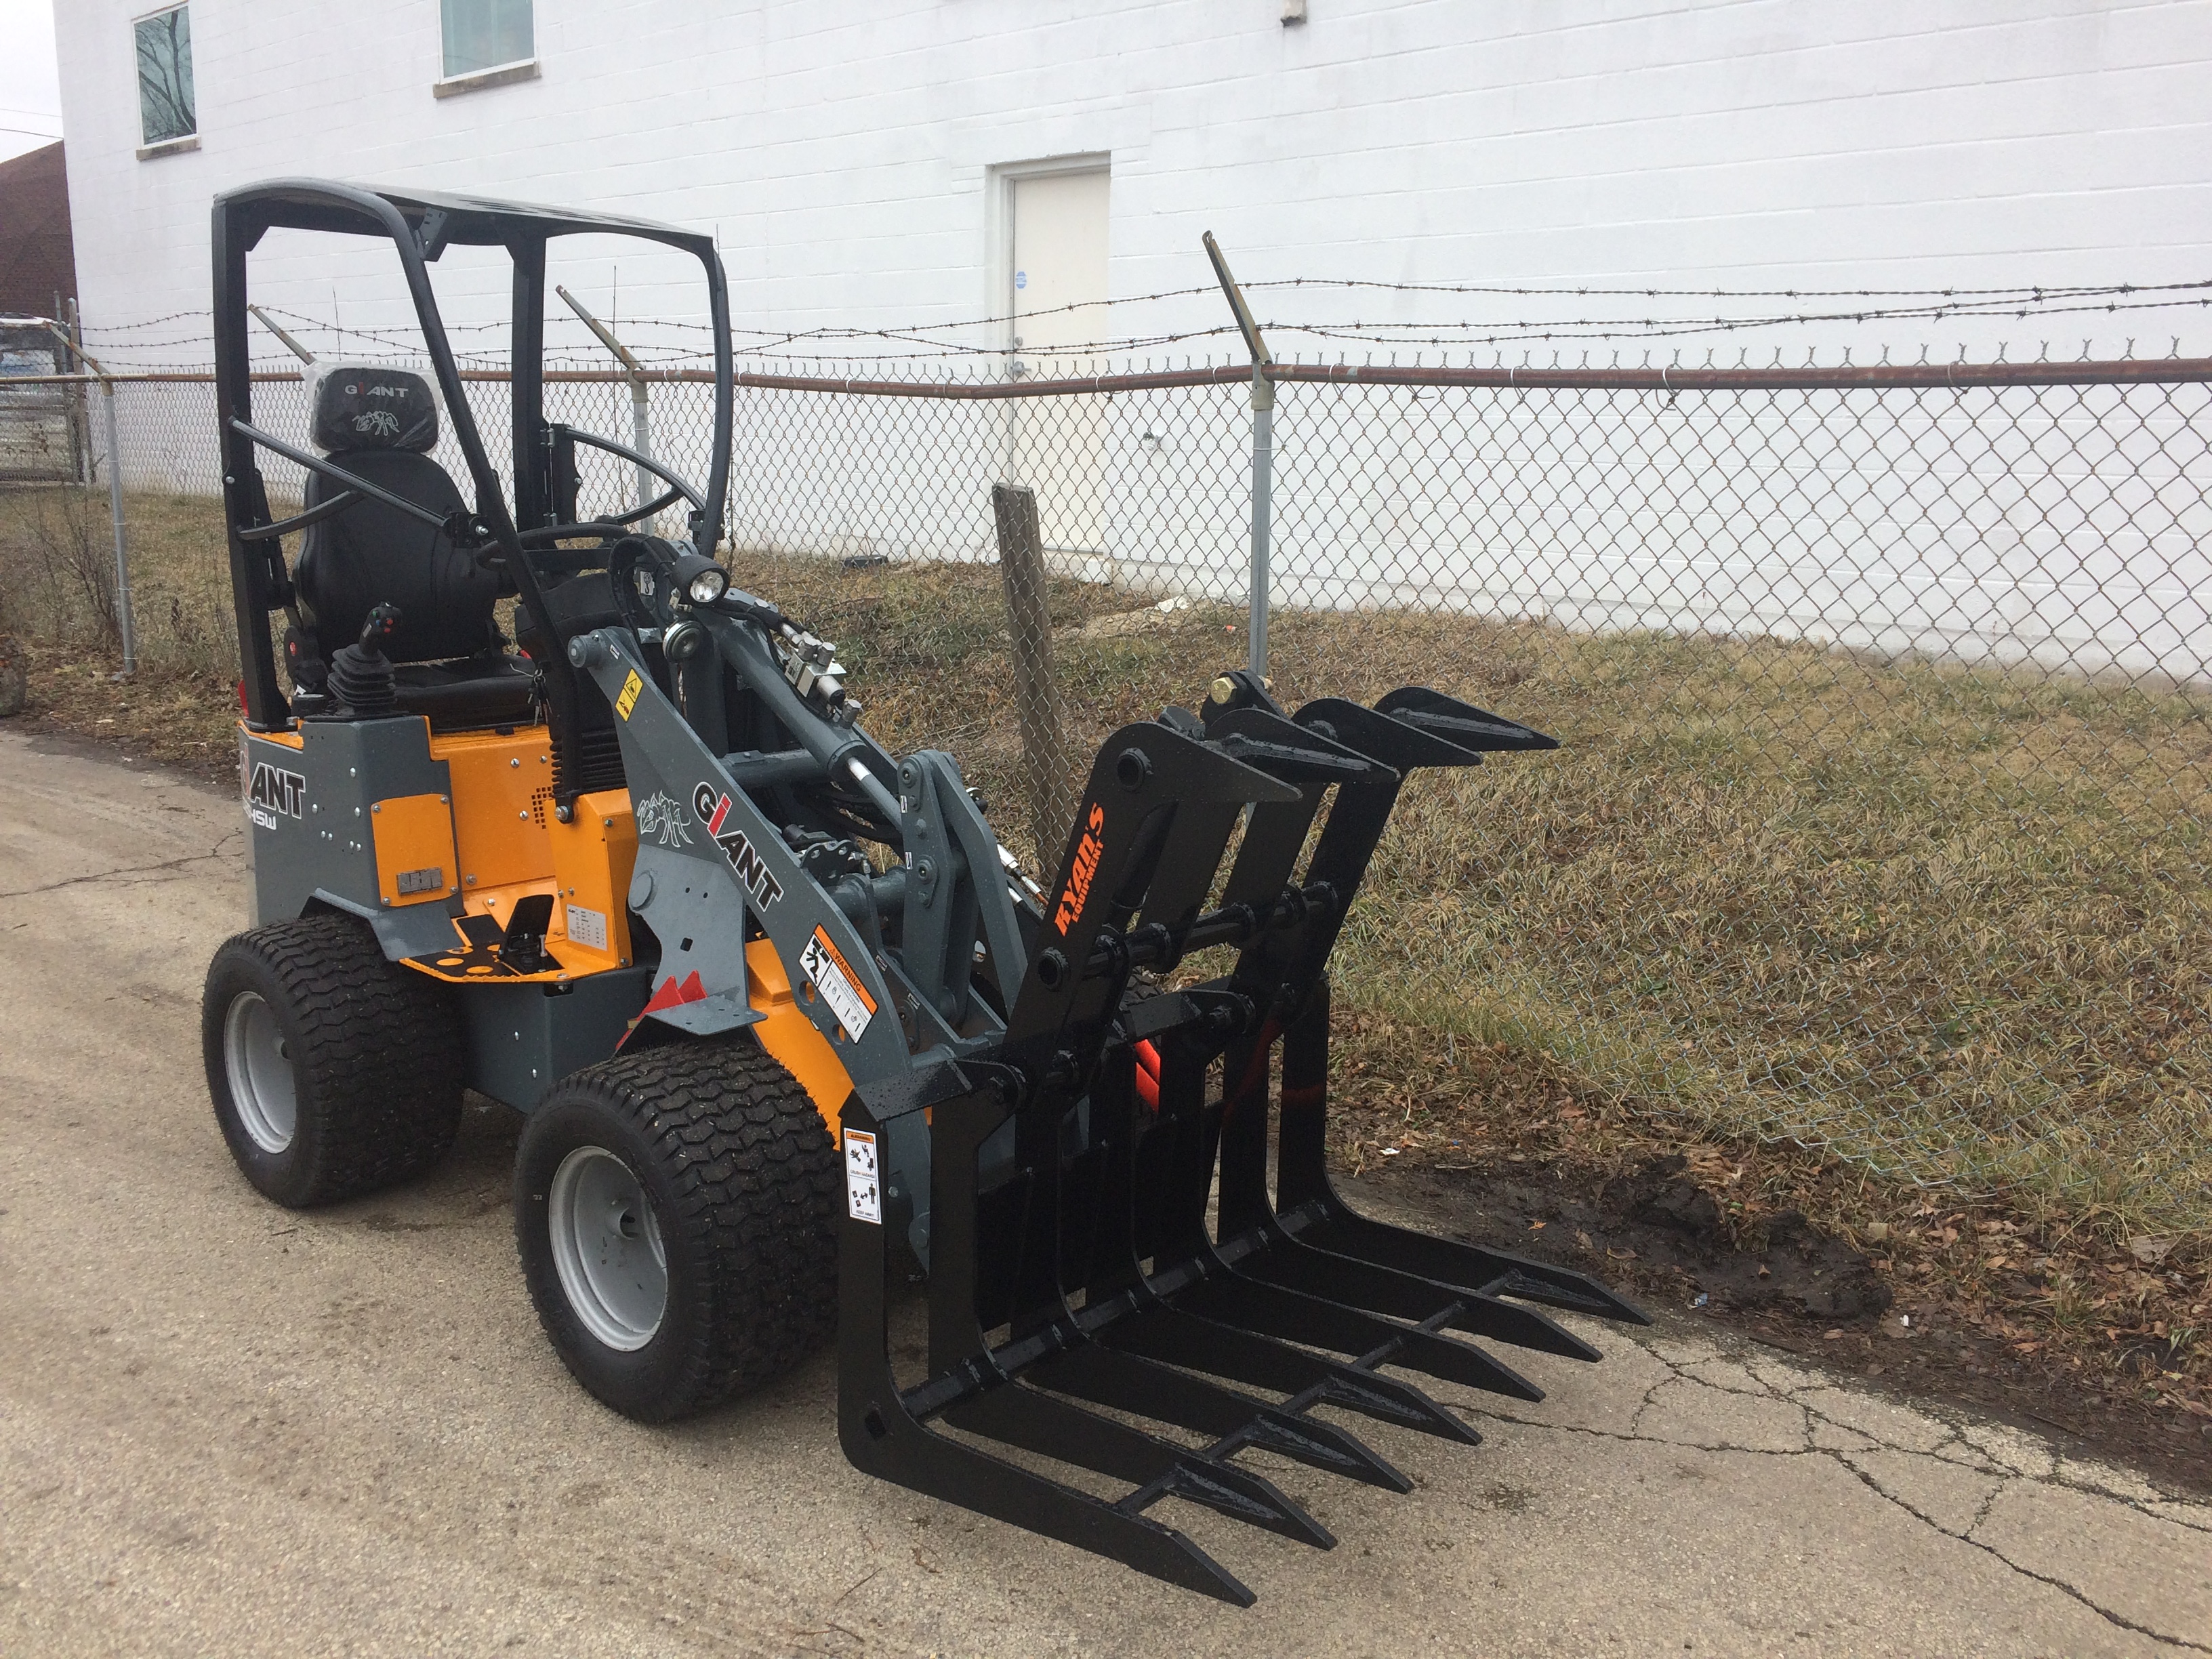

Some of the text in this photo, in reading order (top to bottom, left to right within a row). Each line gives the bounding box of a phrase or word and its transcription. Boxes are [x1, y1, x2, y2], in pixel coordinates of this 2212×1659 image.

[345, 382, 409, 398] GIANT
[693, 781, 784, 912] GIANT
[1054, 802, 1104, 937] RYAN'S
[1071, 839, 1104, 922] EQUIPMENT
[835, 953, 861, 991] WARNING
